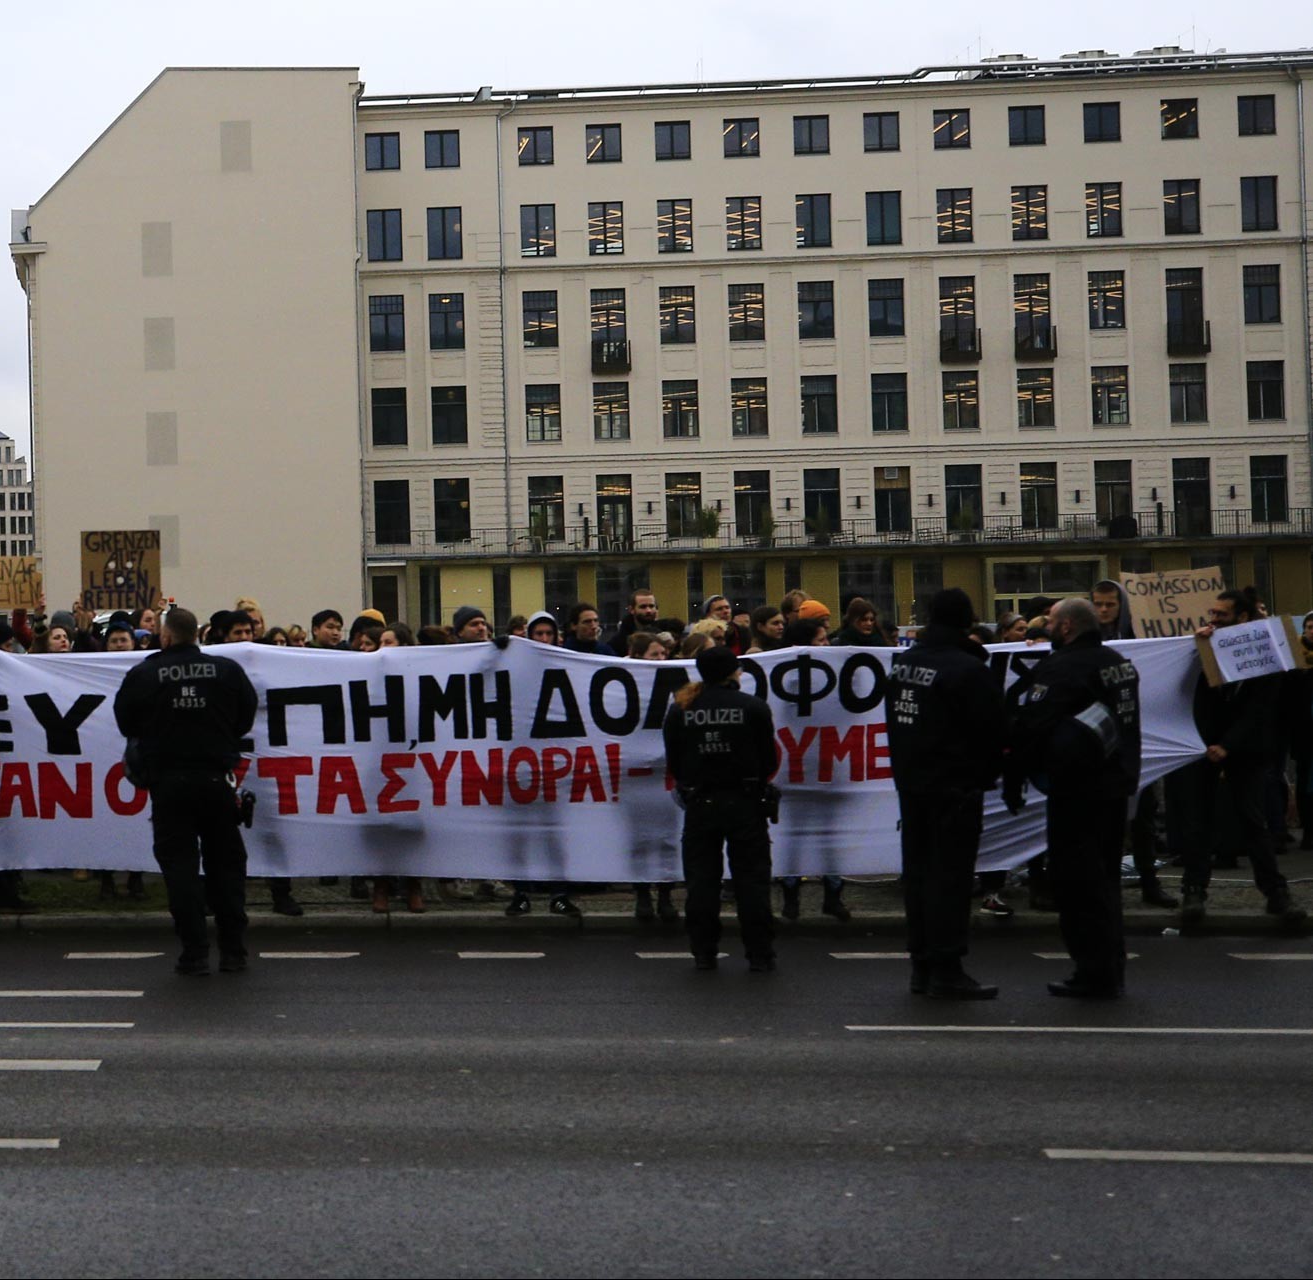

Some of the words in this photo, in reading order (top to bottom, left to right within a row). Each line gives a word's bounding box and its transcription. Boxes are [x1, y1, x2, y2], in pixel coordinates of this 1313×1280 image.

[84, 532, 160, 552] GRENZEN
[90, 570, 148, 591] LEBEN
[84, 587, 155, 610] RETTEN!
[1158, 596, 1178, 614] IS
[158, 663, 217, 683] POLIZEI
[889, 664, 937, 686] POLIZEI
[181, 686, 197, 698] BE
[901, 689, 915, 701] BE
[684, 709, 744, 726] POLIZEI
